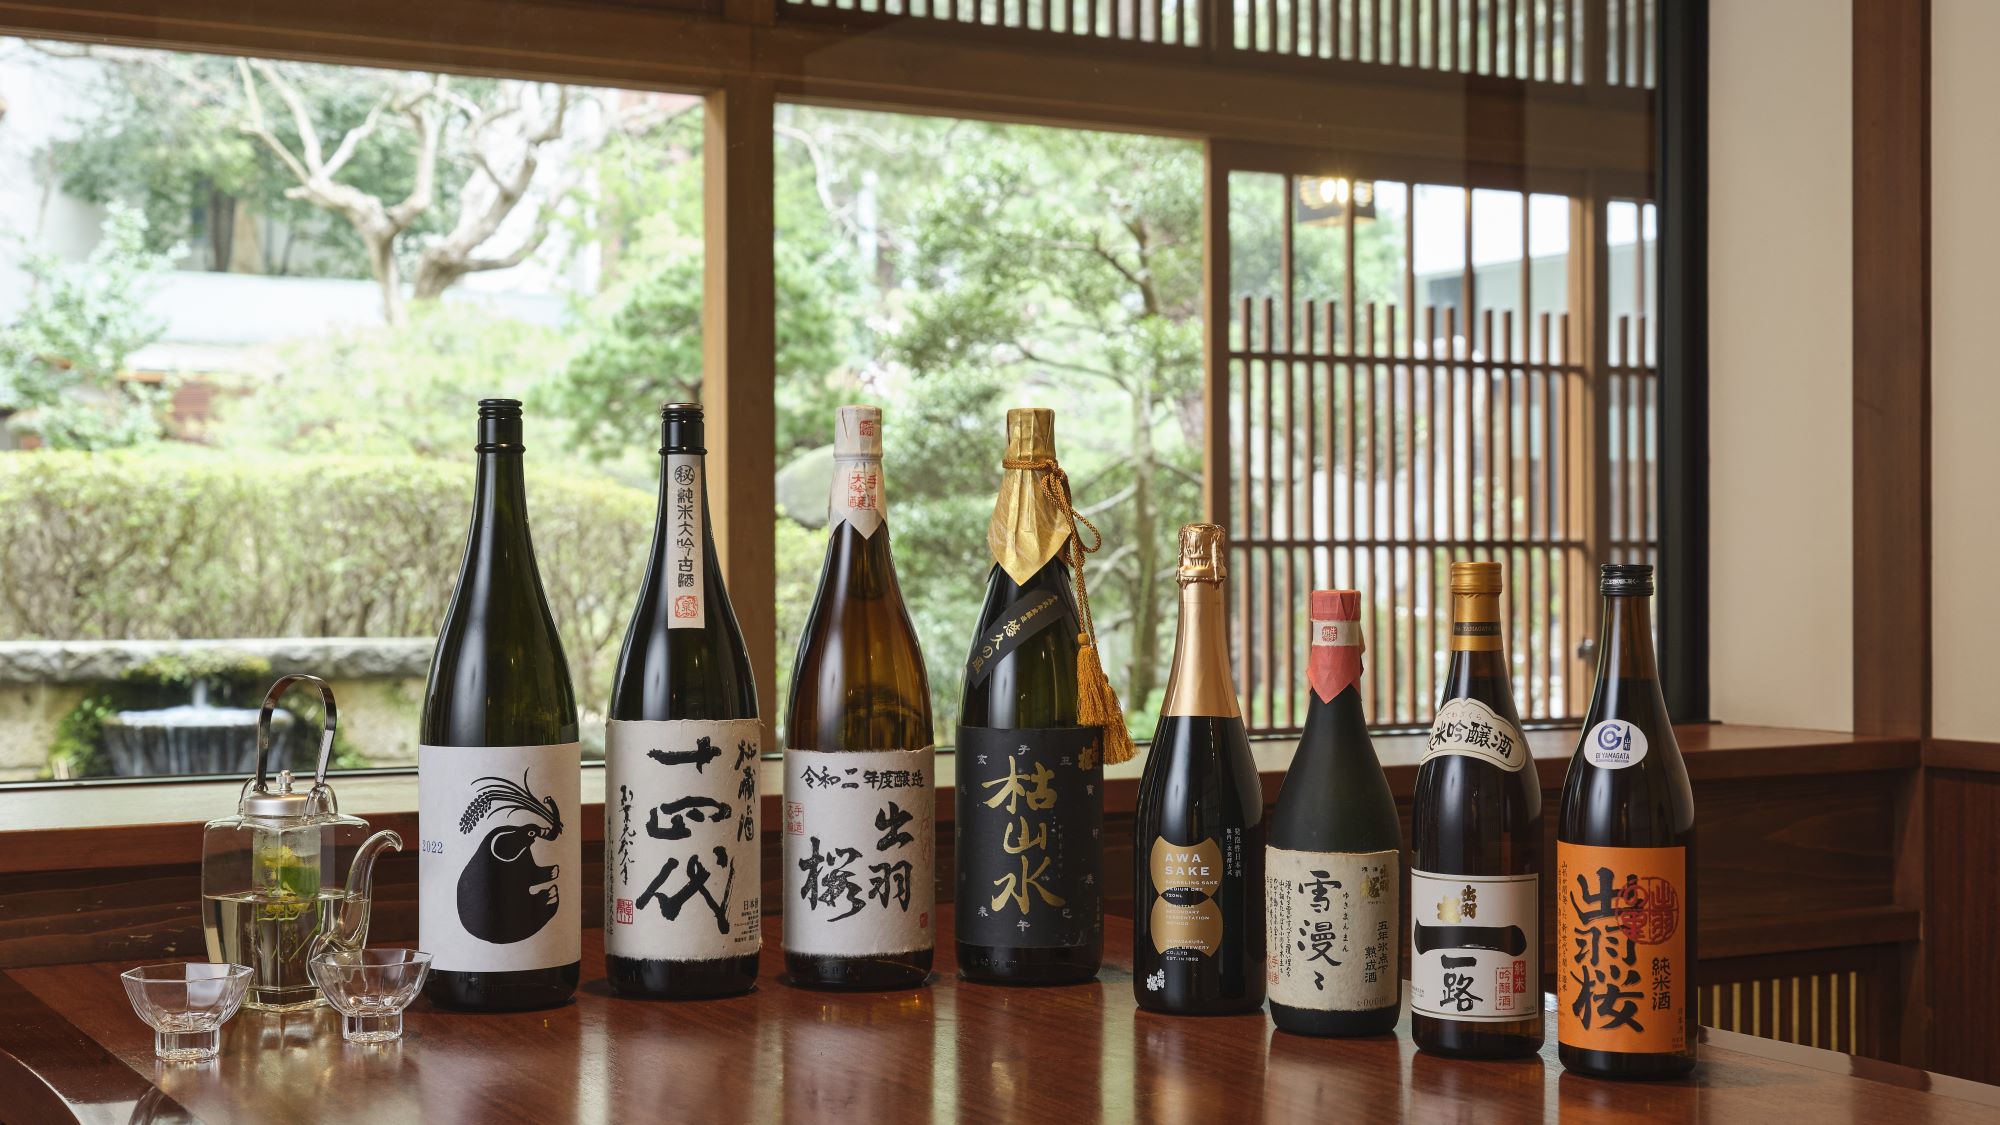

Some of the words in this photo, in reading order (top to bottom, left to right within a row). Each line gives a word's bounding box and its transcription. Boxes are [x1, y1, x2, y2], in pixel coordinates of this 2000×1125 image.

[800, 765, 926, 791] 令和二年度醸造
[422, 840, 444, 854] 2022
[636, 736, 735, 935] 十四代
[982, 755, 1066, 916] 枯山水
[868, 801, 915, 912] 出羽
[1165, 853, 1201, 863] AWA
[1165, 866, 1210, 876] SAKE
[1017, 919, 1031, 932] 午
[1364, 946, 1377, 983] 熟成酒
[1377, 920, 1389, 975] 五年氷点下
[1570, 866, 1645, 1033] 出羽桜
[1498, 969, 1512, 1007] 吟醸酒
[1514, 961, 1526, 992] 純米
[1652, 957, 1671, 1012] 純米酒
